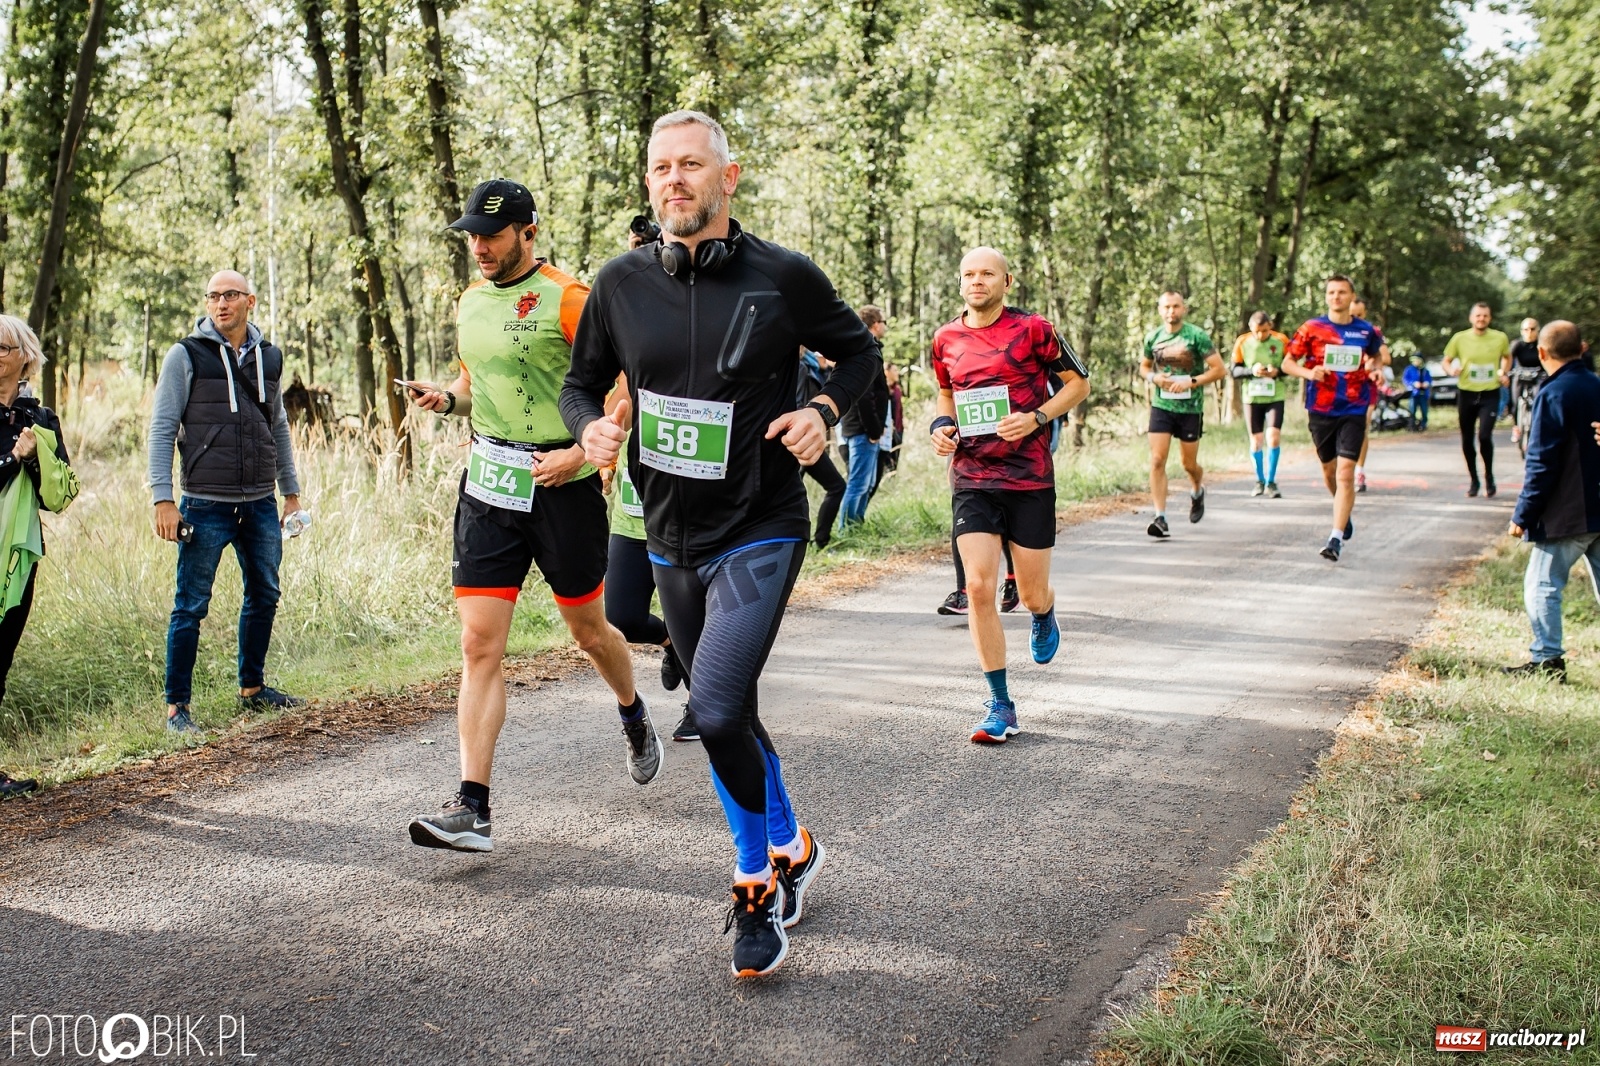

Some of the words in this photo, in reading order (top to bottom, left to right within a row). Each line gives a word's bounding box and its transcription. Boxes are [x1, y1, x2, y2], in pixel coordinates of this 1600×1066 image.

[503, 324, 537, 332] DZIKI
[1332, 354, 1354, 366] 159
[658, 399, 666, 415] V
[963, 402, 997, 425] 130
[657, 421, 699, 457] 58
[478, 460, 518, 494] 154
